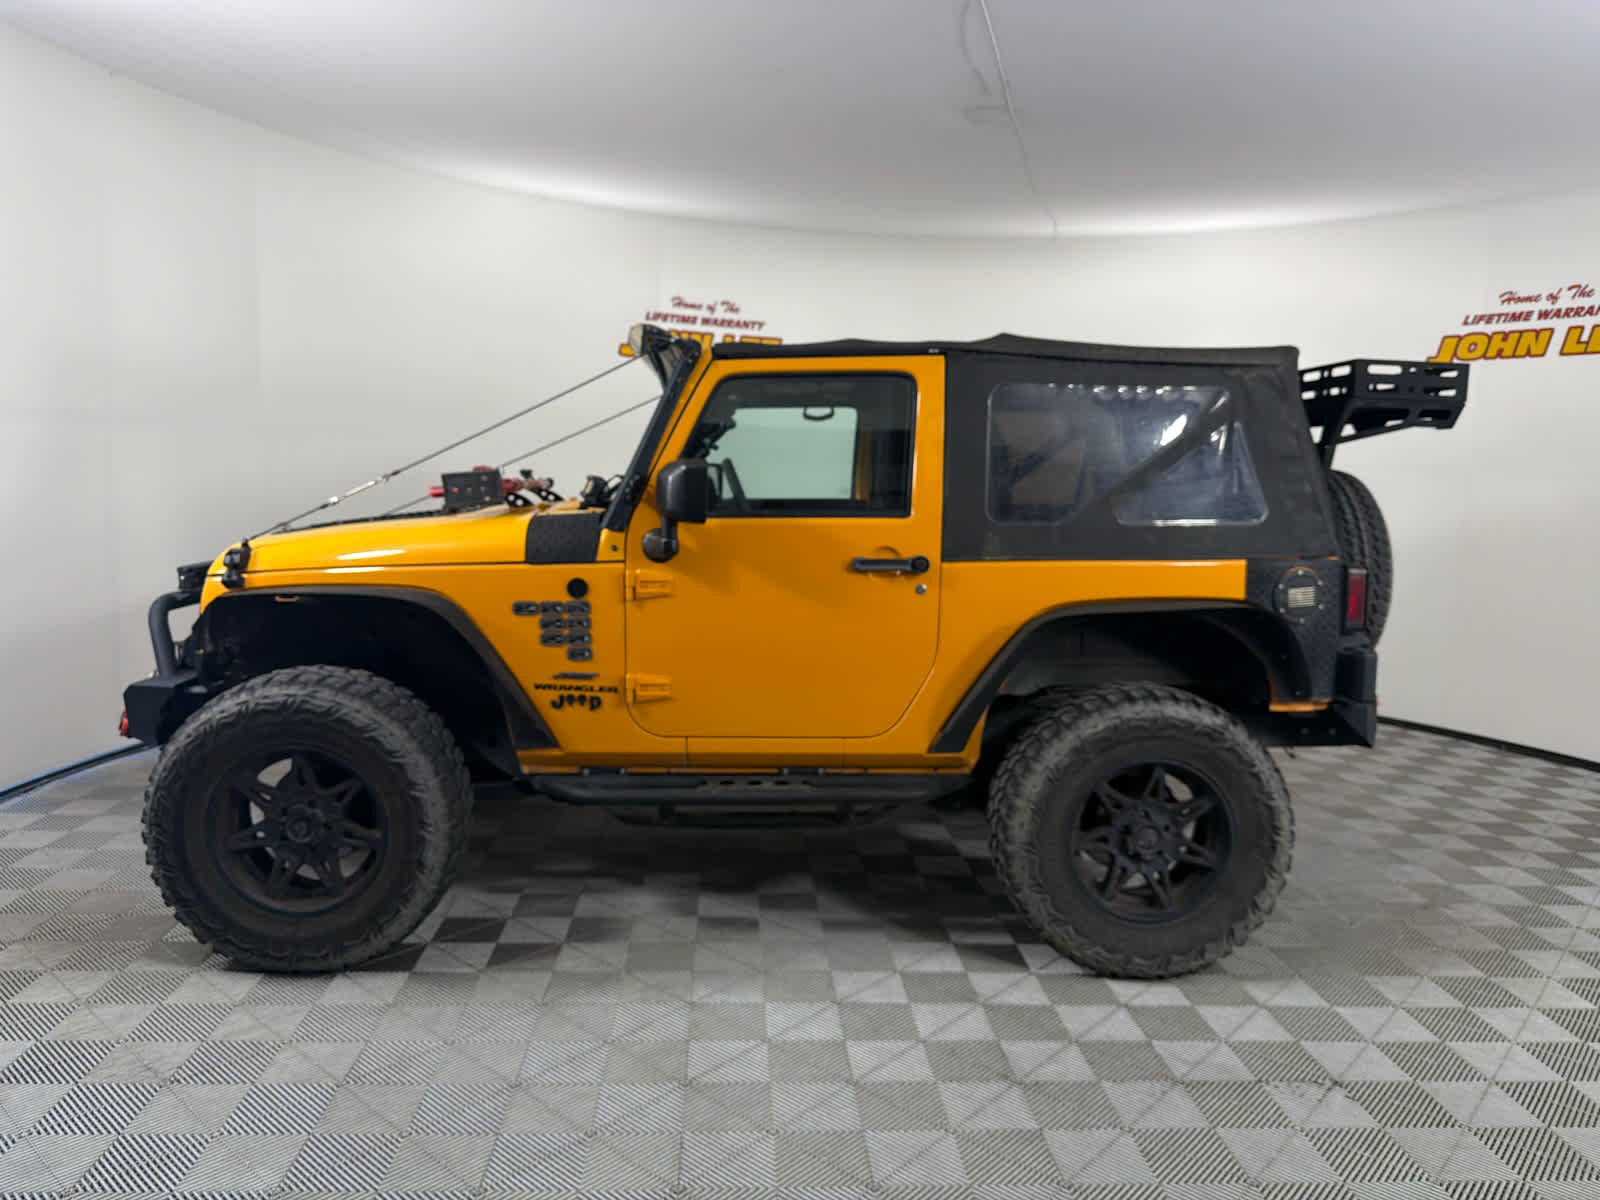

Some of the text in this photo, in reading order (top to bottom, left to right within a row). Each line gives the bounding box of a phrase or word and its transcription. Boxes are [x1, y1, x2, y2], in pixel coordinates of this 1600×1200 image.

[1499, 284, 1595, 305] Home of The
[720, 300, 740, 313] The
[645, 312, 765, 330] LIFETIME WARRANTY
[1462, 309, 1534, 326] LIFETIME
[1426, 328, 1554, 363] JOHN
